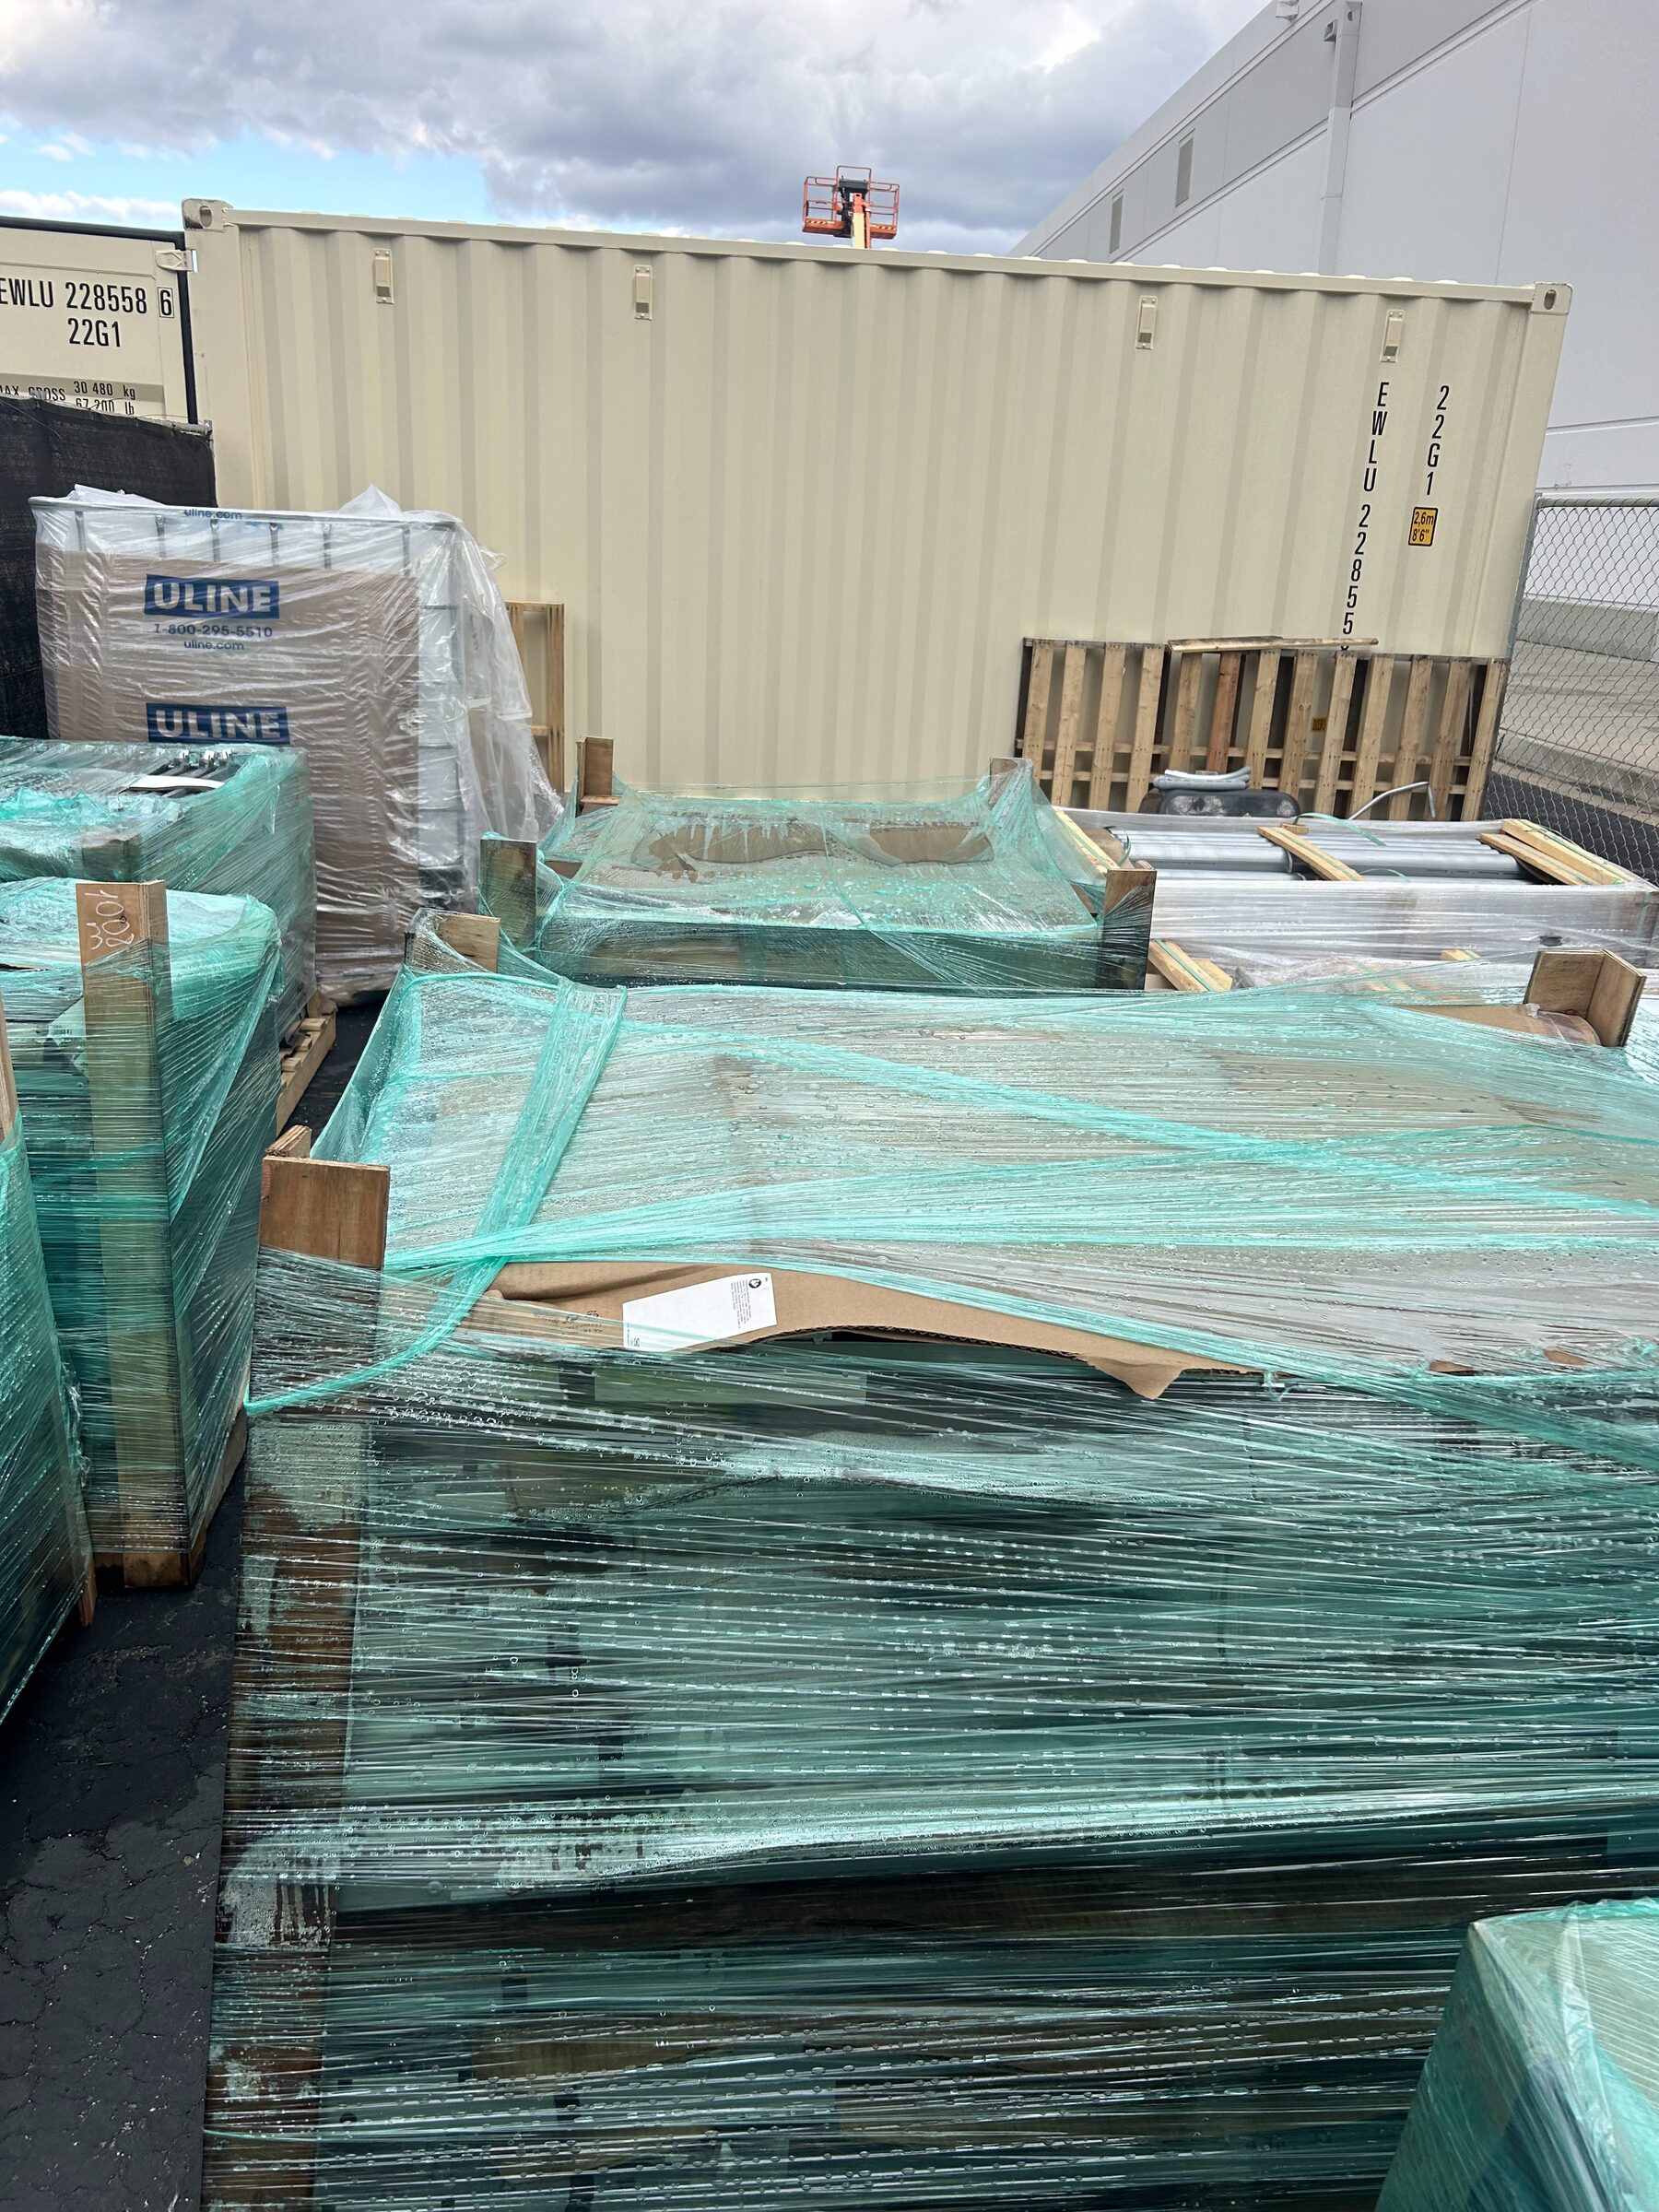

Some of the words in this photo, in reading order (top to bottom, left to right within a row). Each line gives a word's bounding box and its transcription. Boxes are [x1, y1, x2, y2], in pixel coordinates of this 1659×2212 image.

[0, 278, 53, 308] EWLU
[65, 282, 147, 314] 228558
[159, 288, 172, 316] 6
[68, 318, 121, 347] 22G1
[0, 384, 19, 396] AX
[74, 381, 88, 394] 30
[92, 382, 113, 395] 480
[123, 384, 135, 400] kg
[124, 402, 135, 415] lb
[1363, 382, 1389, 492] EWLU
[1426, 385, 1450, 496] 22G1
[183, 509, 242, 520] uline.com
[1340, 504, 1371, 651] 22855
[154, 582, 271, 613] ULINE
[154, 623, 273, 638] 1-800-295-5510
[183, 640, 244, 651] uline.com
[156, 710, 282, 738] ULINE
